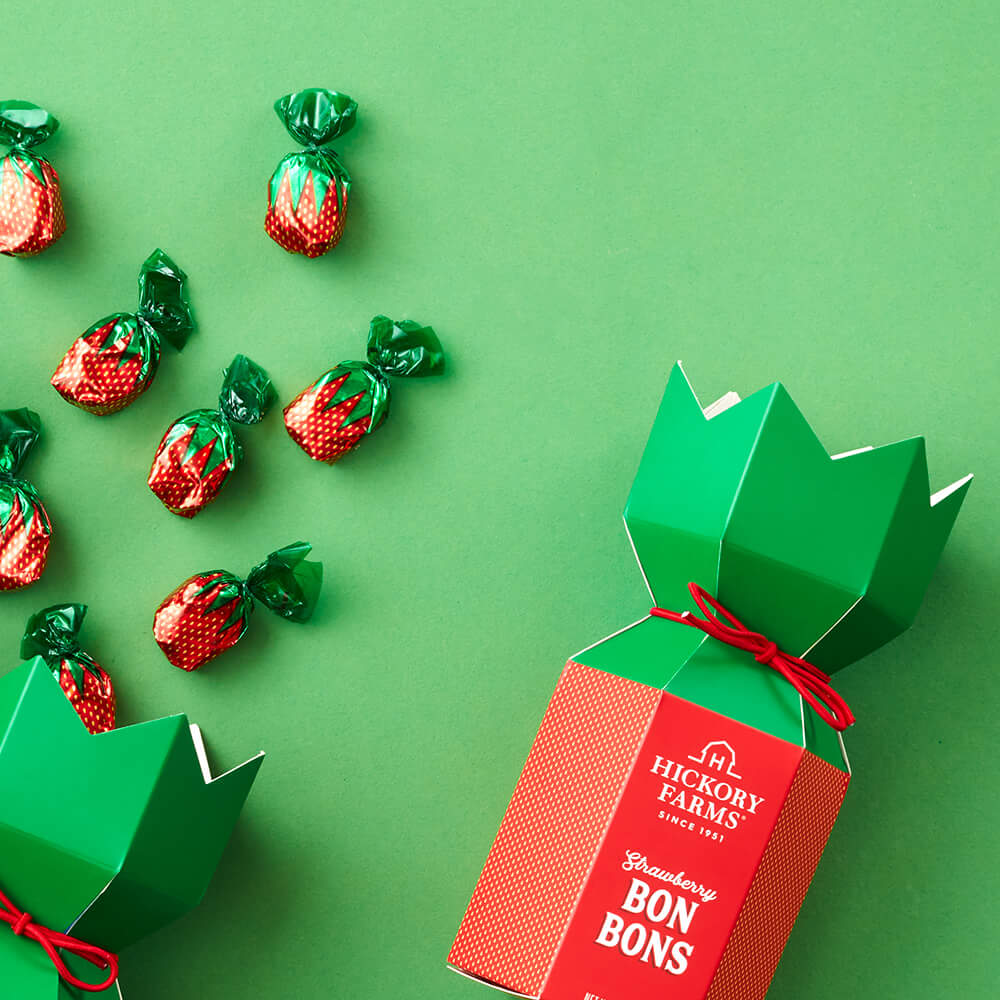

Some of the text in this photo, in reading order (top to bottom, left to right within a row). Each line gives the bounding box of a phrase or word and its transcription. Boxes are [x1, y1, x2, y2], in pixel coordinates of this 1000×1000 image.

[650, 755, 765, 814] HICKORY
[658, 810, 724, 843] SINCE 1951
[622, 849, 717, 902] Strawberry
[621, 877, 700, 934] BON
[595, 911, 694, 975] BONS
